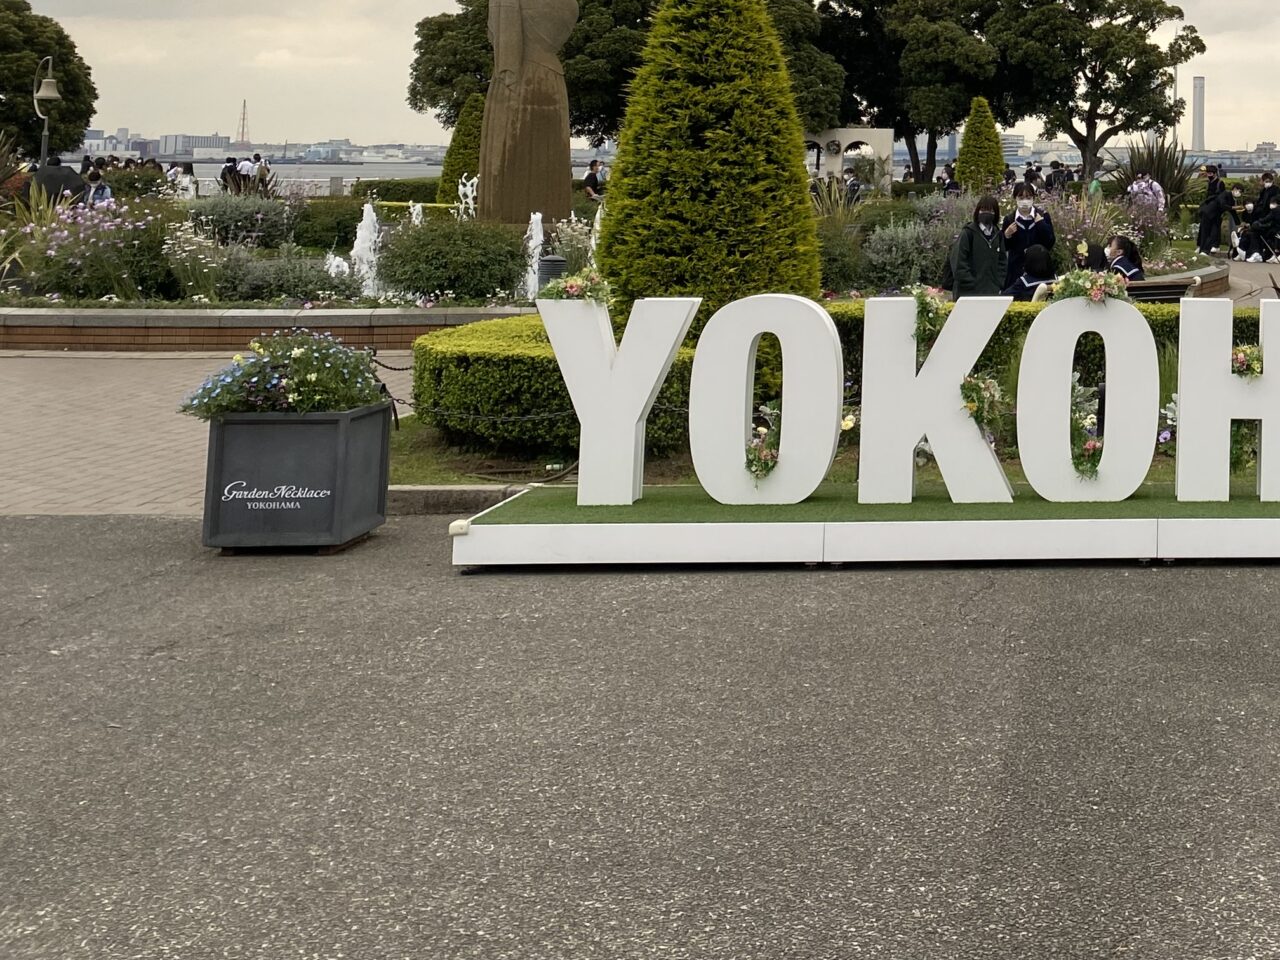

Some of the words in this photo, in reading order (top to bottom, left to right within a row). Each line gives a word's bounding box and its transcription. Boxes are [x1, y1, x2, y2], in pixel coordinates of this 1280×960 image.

[222, 480, 269, 501] Garden
[269, 485, 330, 499] Necklace
[246, 502, 301, 510] YOKOHAMA
